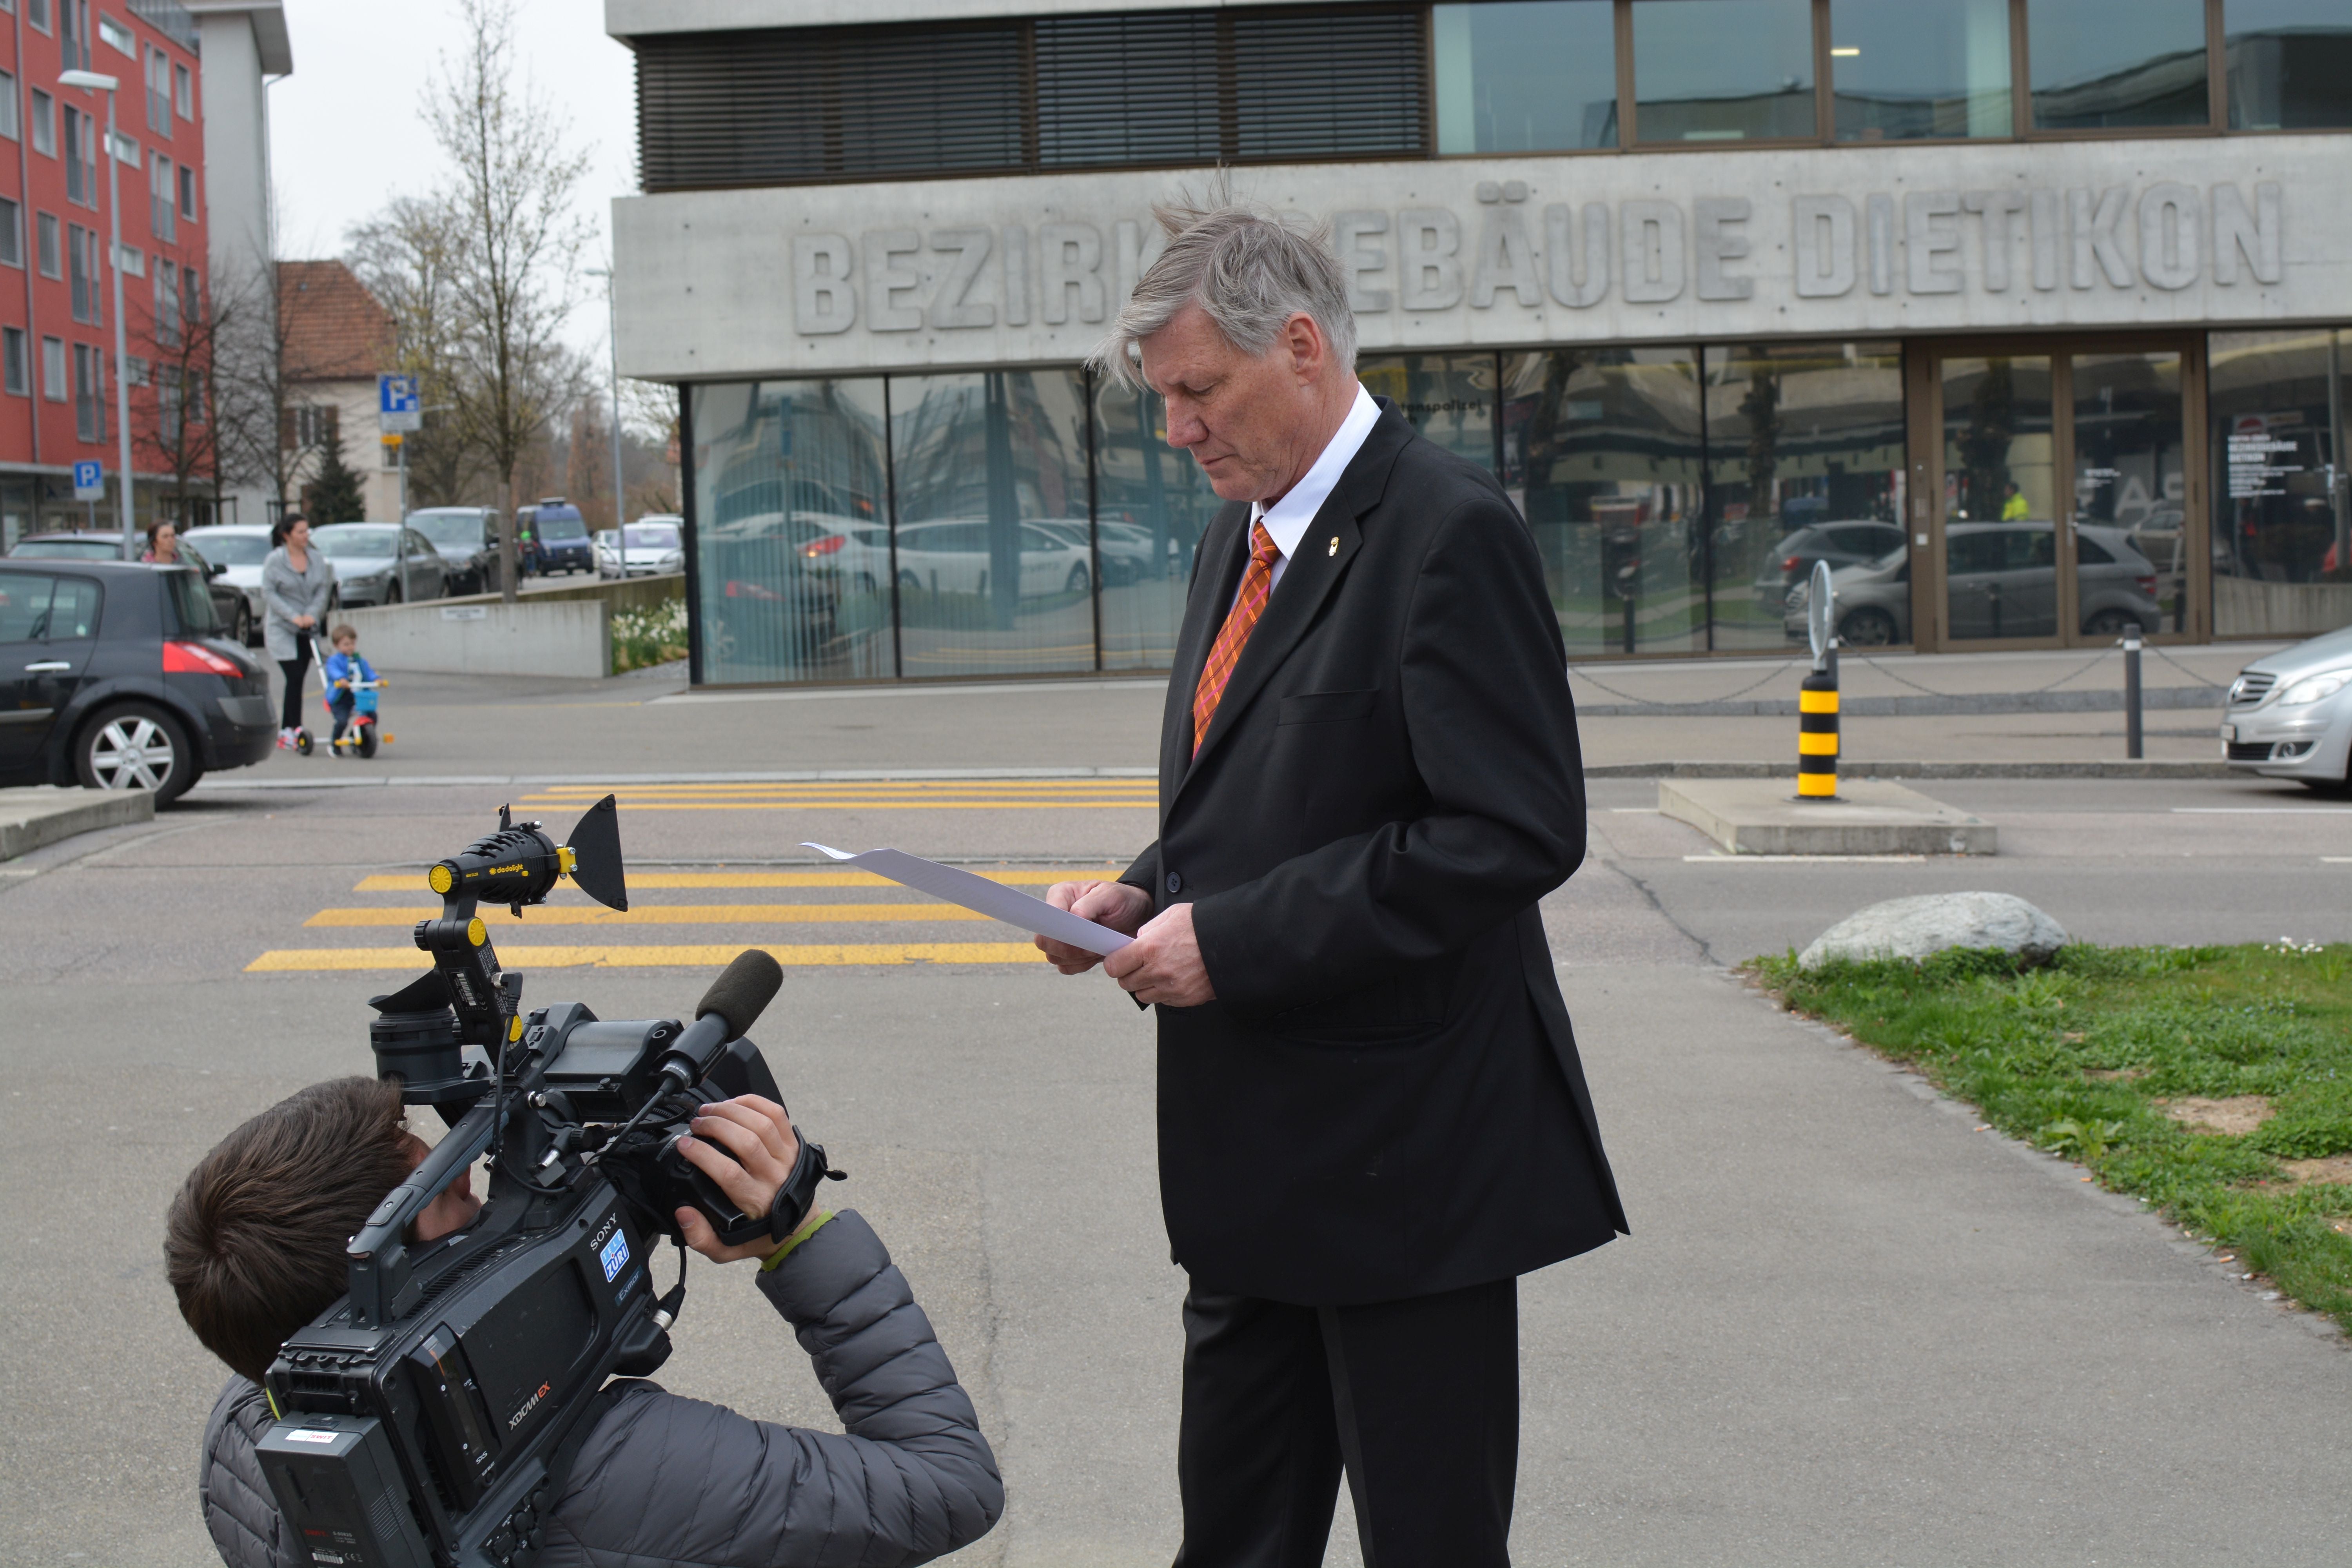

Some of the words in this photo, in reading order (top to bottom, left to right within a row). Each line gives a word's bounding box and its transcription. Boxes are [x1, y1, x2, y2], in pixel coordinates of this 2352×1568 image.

[1793, 181, 2283, 299] DIETIKON
[389, 380, 408, 410] P
[81, 465, 95, 485] P
[497, 864, 523, 873] dedolight
[590, 1212, 617, 1251] SONY
[603, 1233, 622, 1260] TELE
[619, 1270, 639, 1302] Exmor
